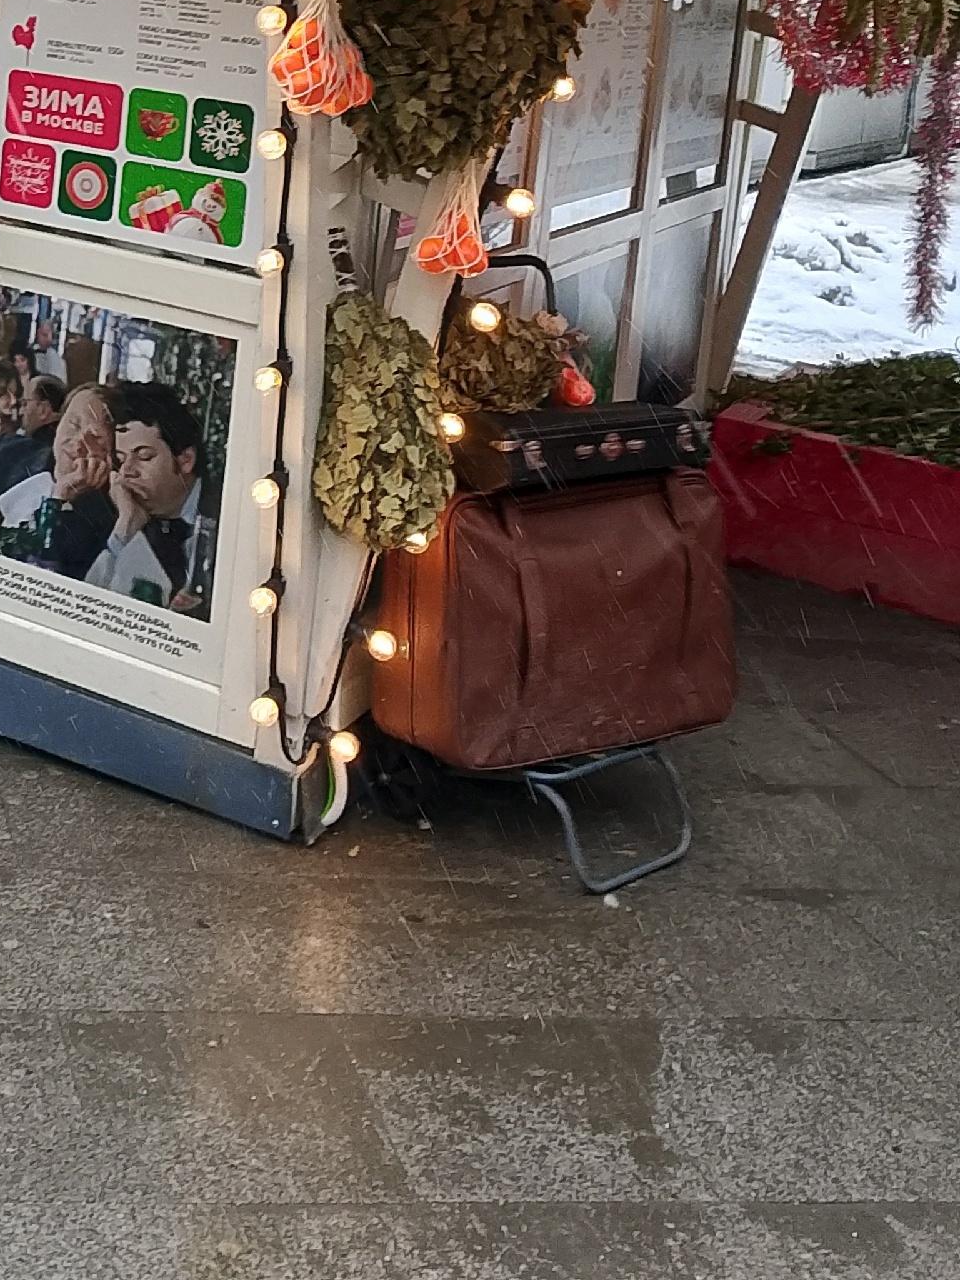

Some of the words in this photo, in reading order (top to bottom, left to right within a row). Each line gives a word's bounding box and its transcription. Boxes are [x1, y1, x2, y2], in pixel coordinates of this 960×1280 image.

[22, 85, 105, 119] ЗИМА
[21, 110, 32, 123] В
[36, 112, 105, 135] МОСКВЕ
